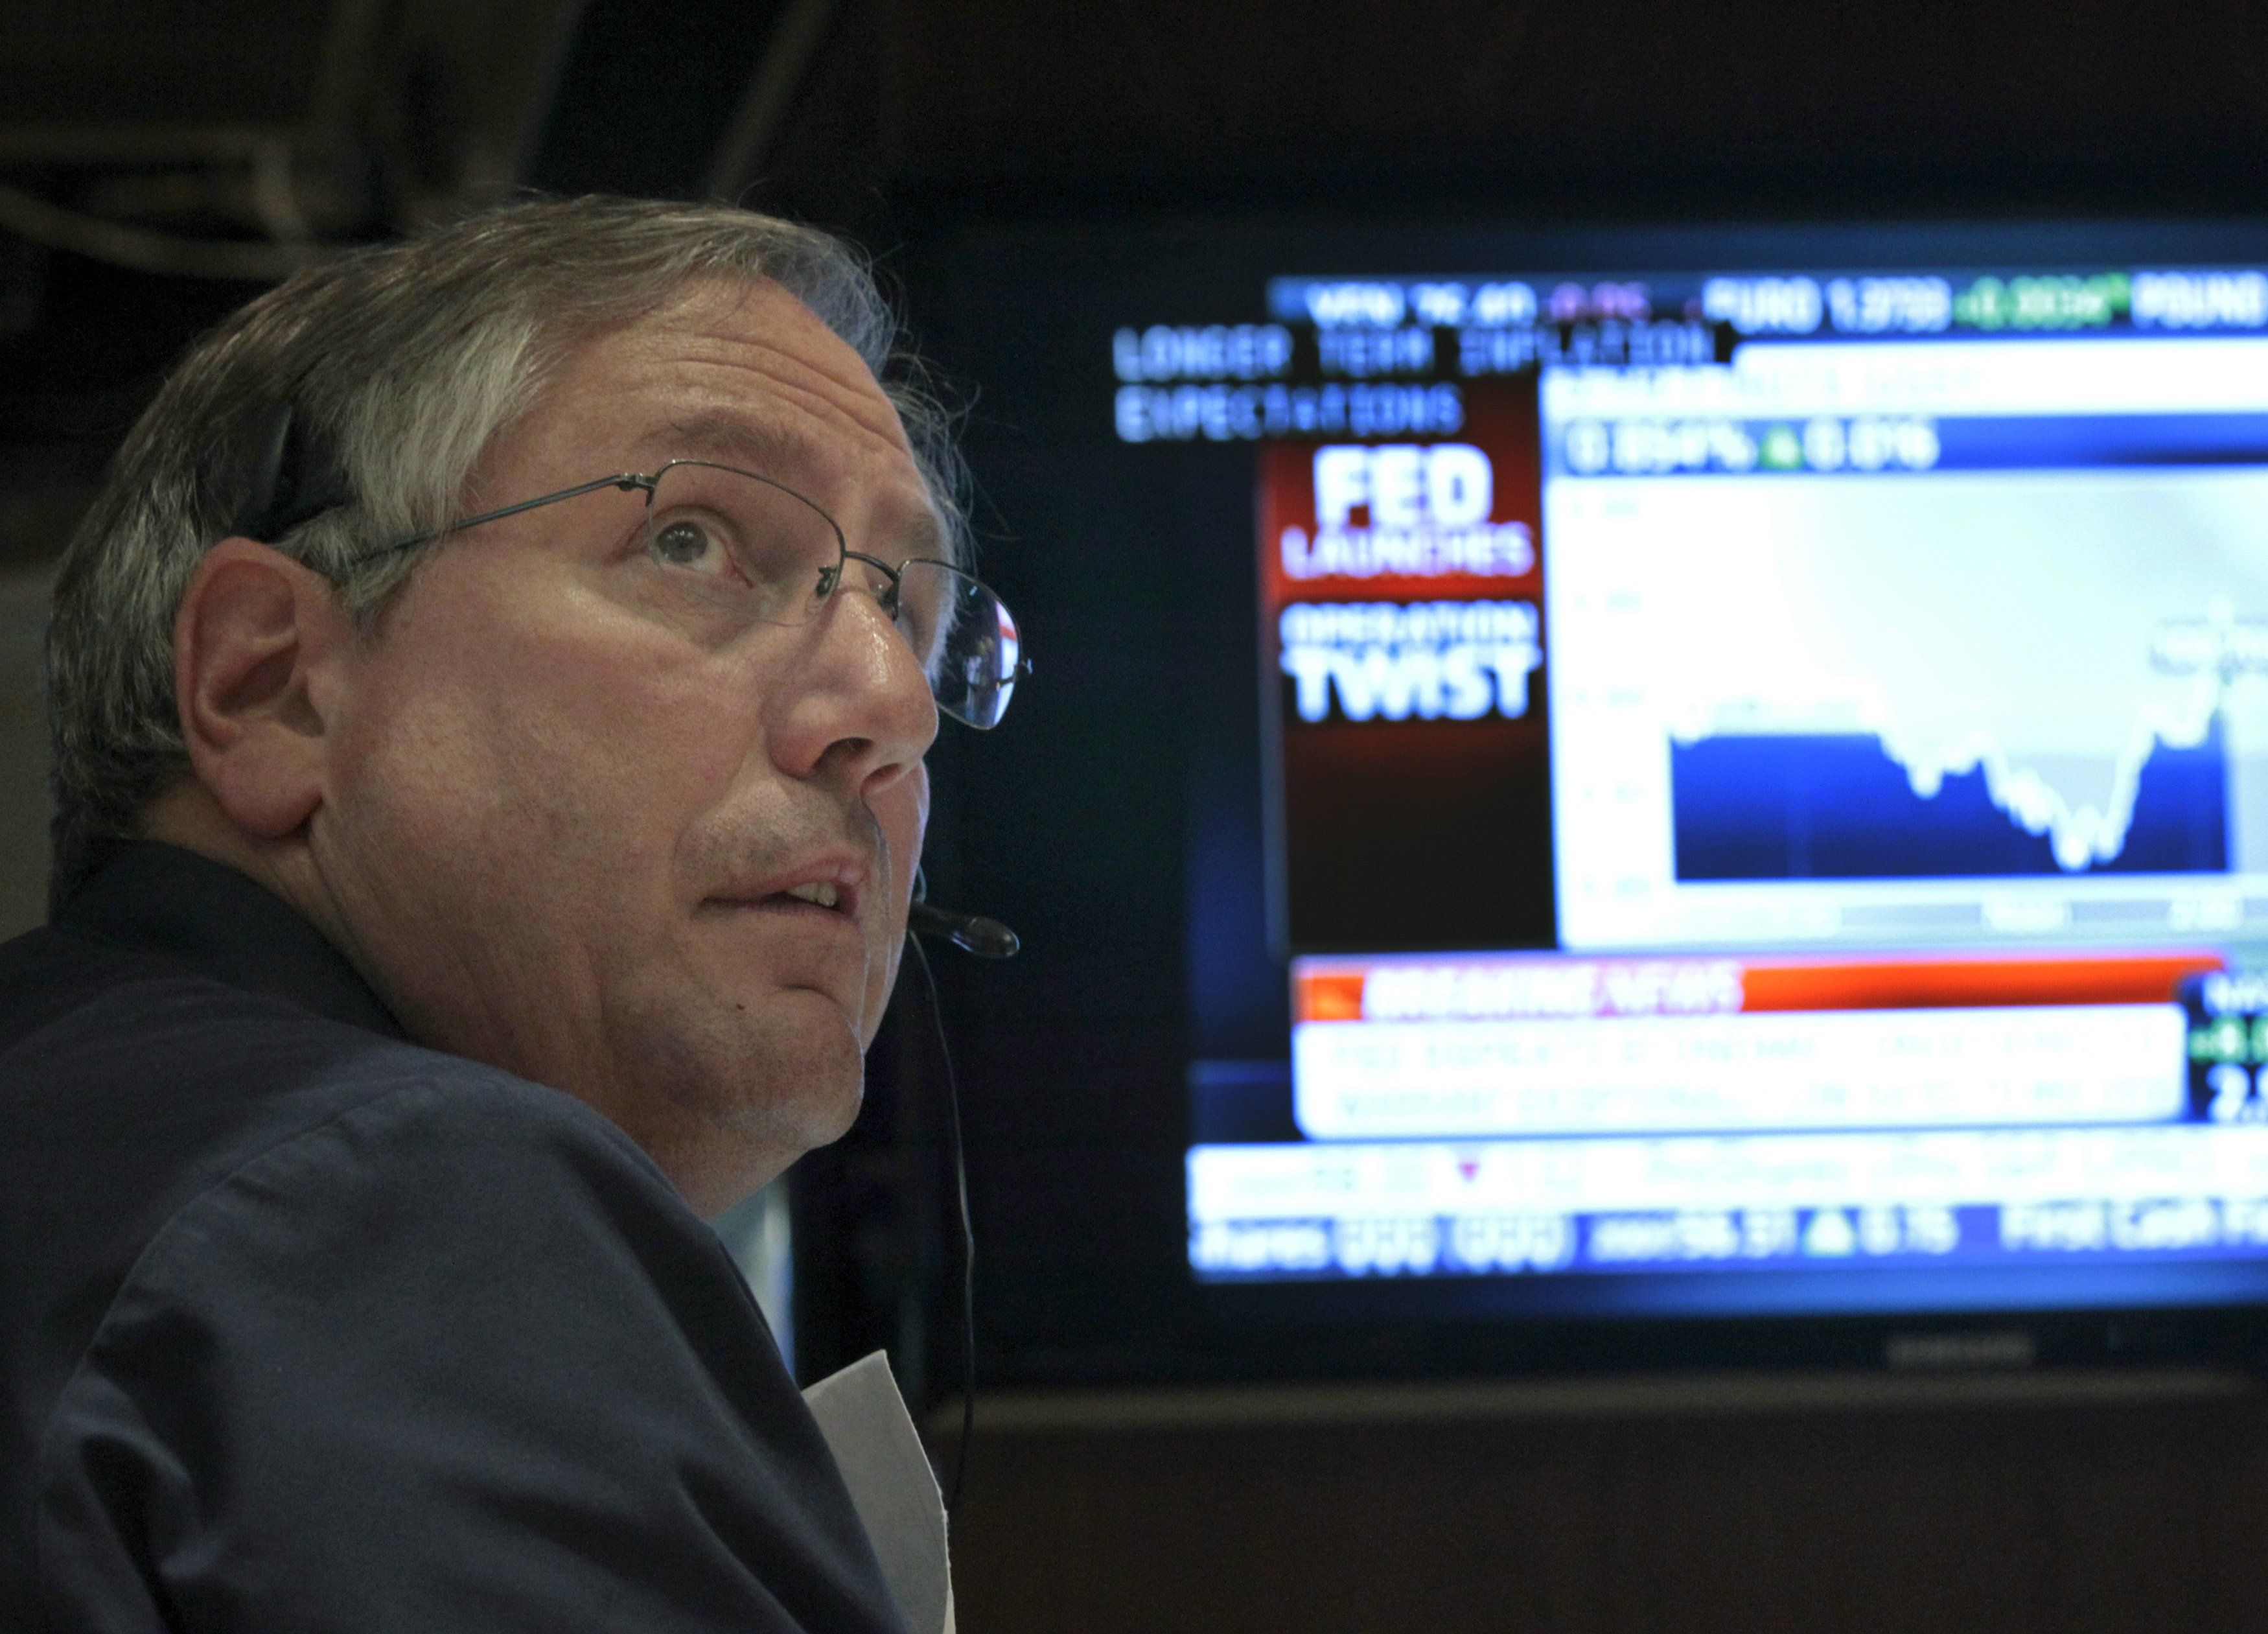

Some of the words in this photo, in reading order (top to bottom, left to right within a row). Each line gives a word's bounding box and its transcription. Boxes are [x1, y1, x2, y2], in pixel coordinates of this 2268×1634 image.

[1702, 276, 1822, 334] EURO
[1114, 325, 1292, 382] LONGER
[1317, 326, 1435, 377] TERM
[1458, 321, 1715, 376] INFLATION
[1115, 383, 1464, 442] EXPECTATIONS
[1313, 444, 1493, 528] FED
[1281, 522, 1535, 579] LAUNCHES
[1279, 601, 1541, 647] OPERATION
[1279, 643, 1543, 721] TWIST
[1362, 965, 1597, 1020] BREAKING
[1601, 961, 1743, 1016] NEWS
